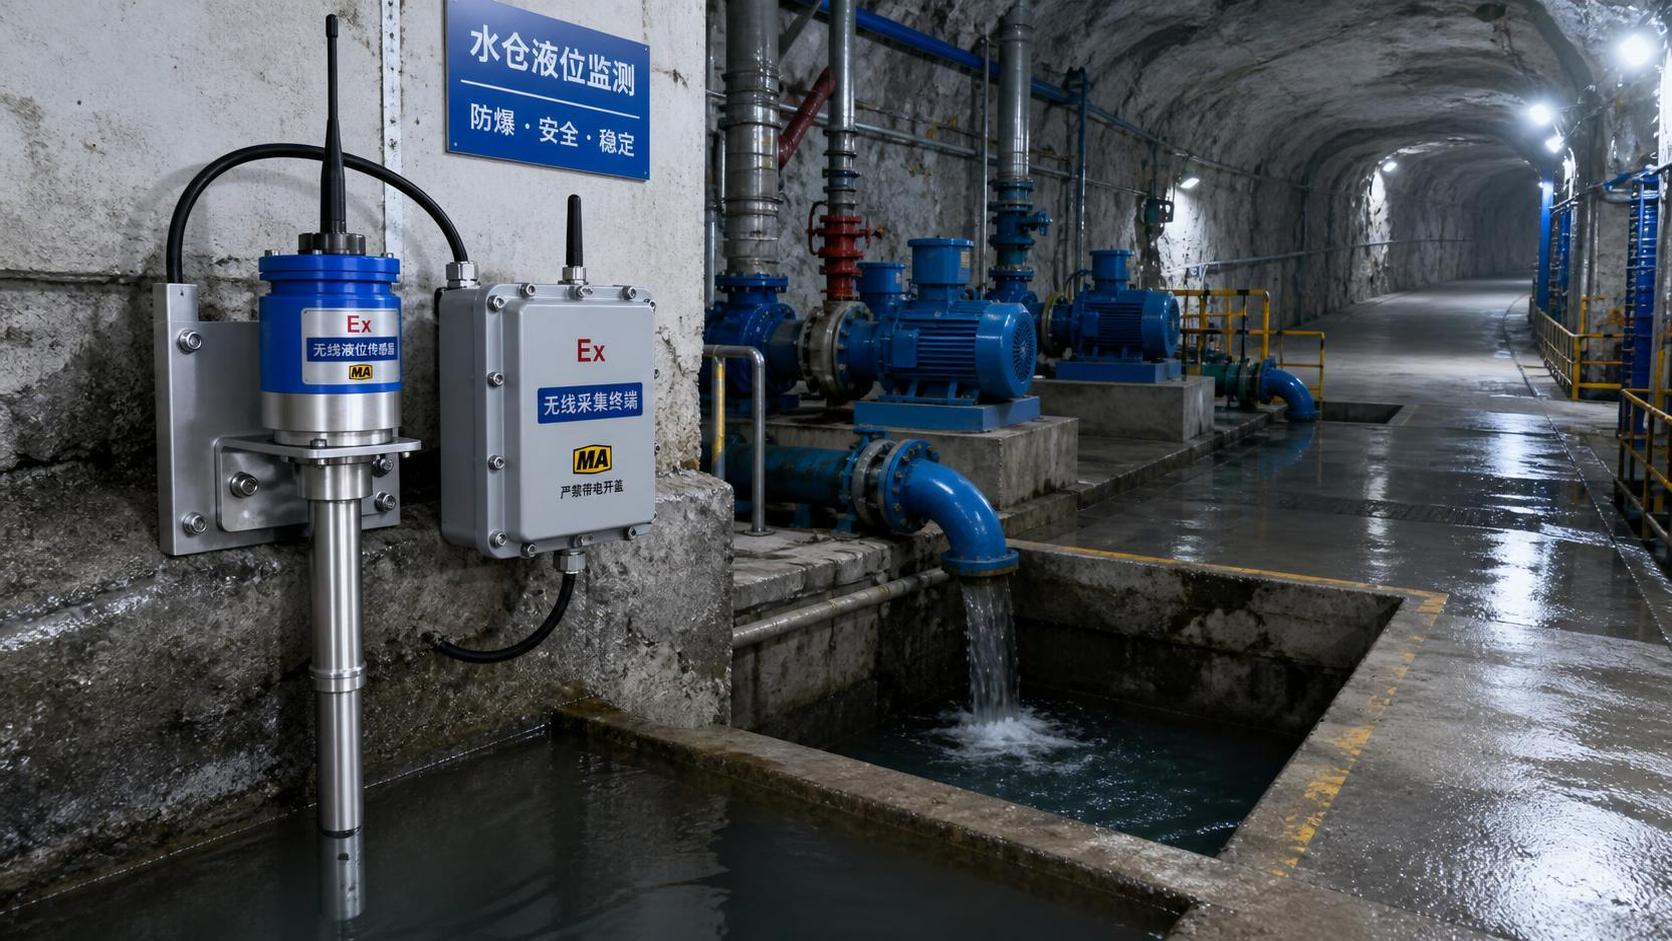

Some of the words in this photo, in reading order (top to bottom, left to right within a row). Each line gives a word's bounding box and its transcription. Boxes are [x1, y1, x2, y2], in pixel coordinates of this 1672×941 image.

[470, 24, 635, 97] 水仓液位监测
[347, 315, 372, 333] Ex
[577, 338, 606, 363] Ex
[350, 365, 372, 379] MA
[544, 390, 638, 416] 无线采集终端
[576, 449, 610, 471] MA
